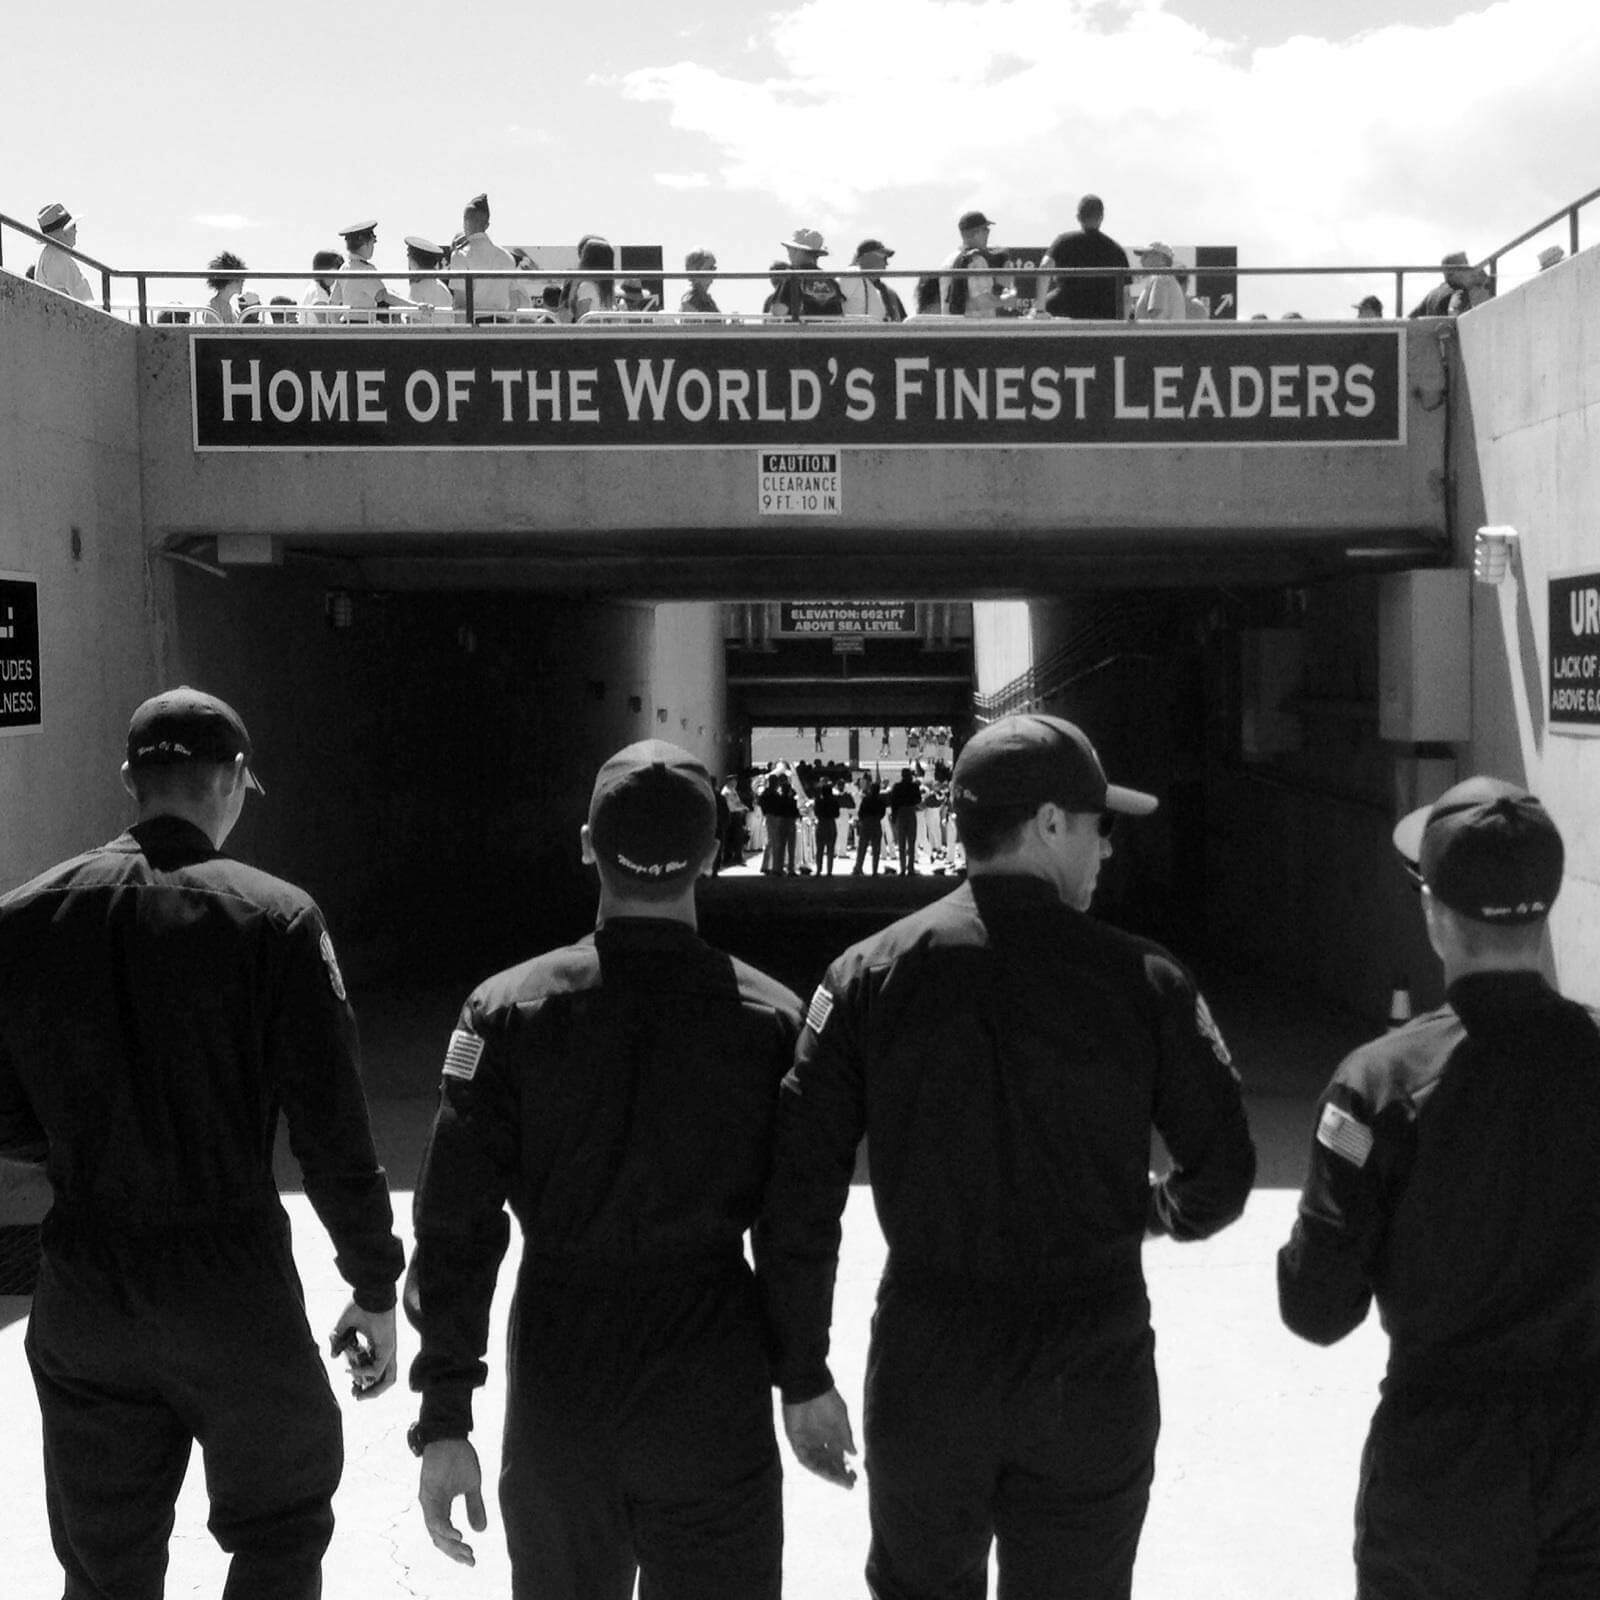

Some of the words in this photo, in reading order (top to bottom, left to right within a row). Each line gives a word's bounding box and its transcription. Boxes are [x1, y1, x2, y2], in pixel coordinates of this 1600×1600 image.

[220, 359, 388, 423] HOME
[404, 368, 476, 423] OF
[491, 368, 600, 423] THE
[894, 356, 1096, 420] FINEST
[1113, 355, 1376, 419] LEADERS
[769, 455, 831, 472] CAUTION
[763, 476, 837, 492] CLEARANCE
[762, 494, 772, 510] 9
[1570, 588, 1600, 636] UR
[795, 621, 835, 631] ABOVE
[838, 621, 861, 631] SEA
[865, 621, 901, 631] LEVEL
[1554, 656, 1581, 679] LACK
[1582, 655, 1597, 678] OF
[1552, 689, 1586, 711] ABOVE
